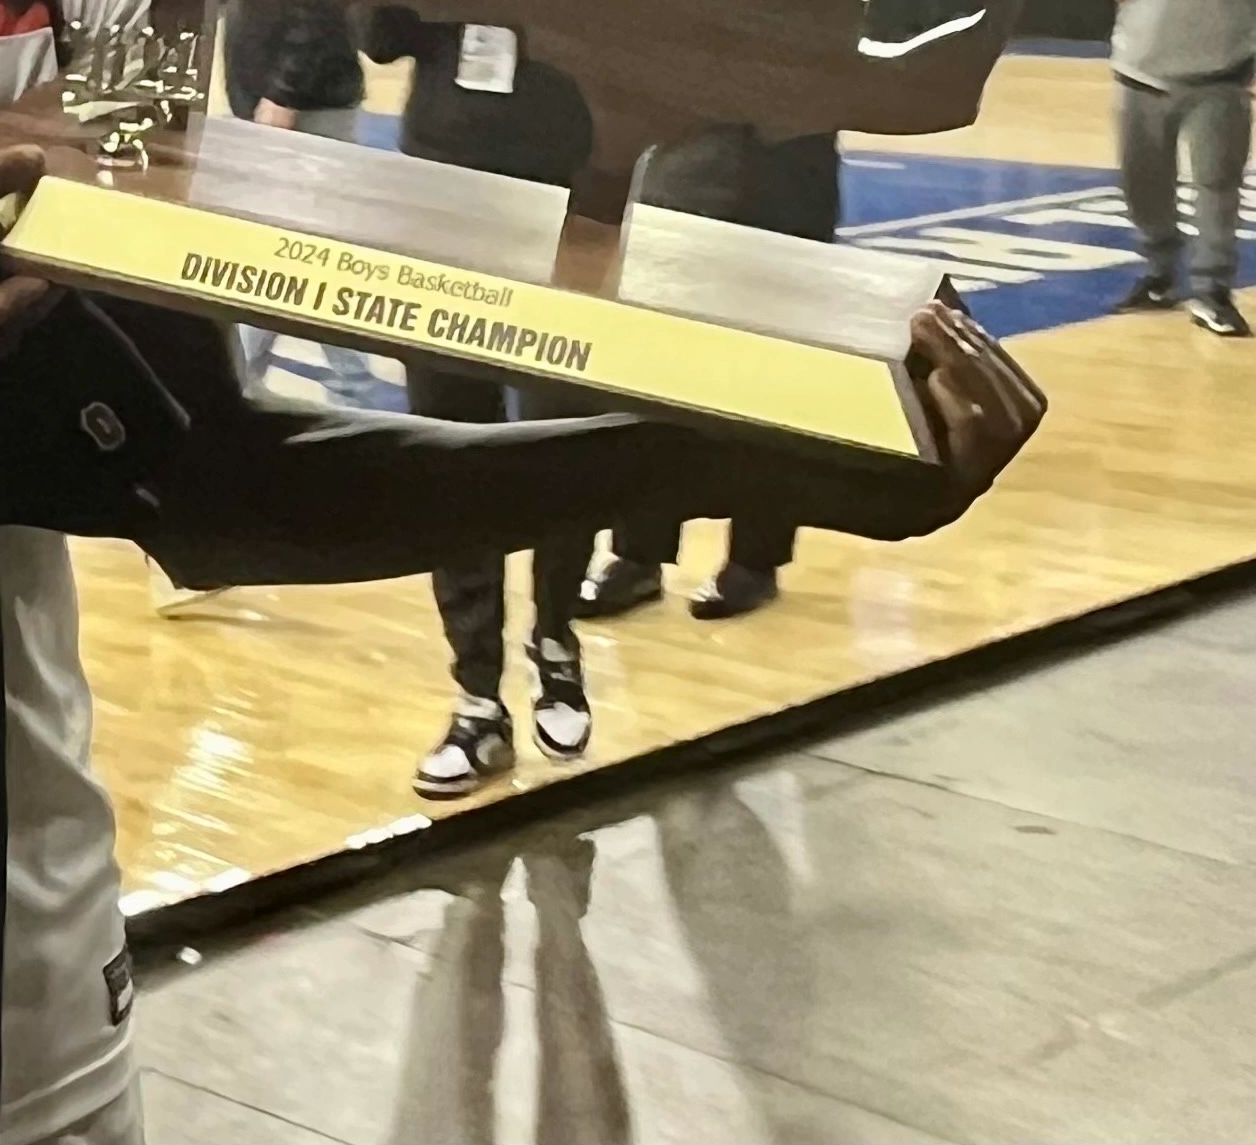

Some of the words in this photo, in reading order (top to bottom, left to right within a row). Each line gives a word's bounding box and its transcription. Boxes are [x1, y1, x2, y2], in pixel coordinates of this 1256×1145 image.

[180, 252, 309, 306] DIVISION
[332, 287, 422, 332] STATE
[426, 308, 593, 373] CHAMPION
[272, 237, 330, 267] 2024
[336, 251, 390, 283] Boys
[396, 265, 514, 308] Basketball
